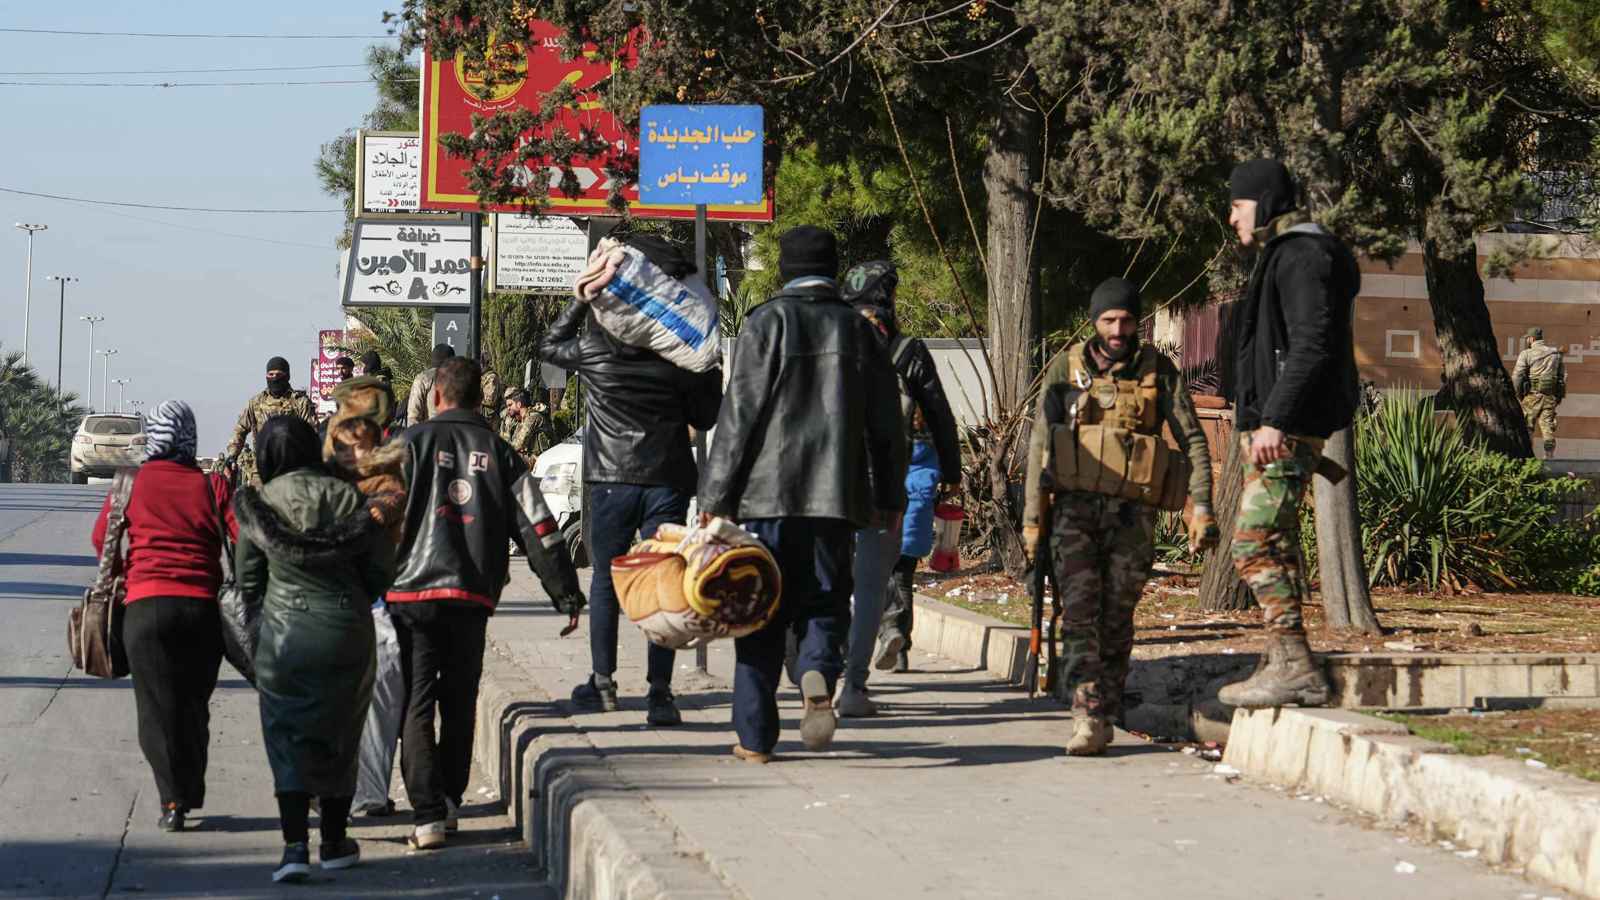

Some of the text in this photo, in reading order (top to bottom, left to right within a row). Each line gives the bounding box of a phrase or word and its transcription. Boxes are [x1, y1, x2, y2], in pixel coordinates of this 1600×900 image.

[647, 121, 719, 150] الجديدة
[721, 123, 756, 150] حلب
[372, 151, 408, 167] الجلاد
[371, 169, 394, 178] الأطفال
[657, 162, 748, 189] موقف باس
[397, 227, 441, 246] ضيافة
